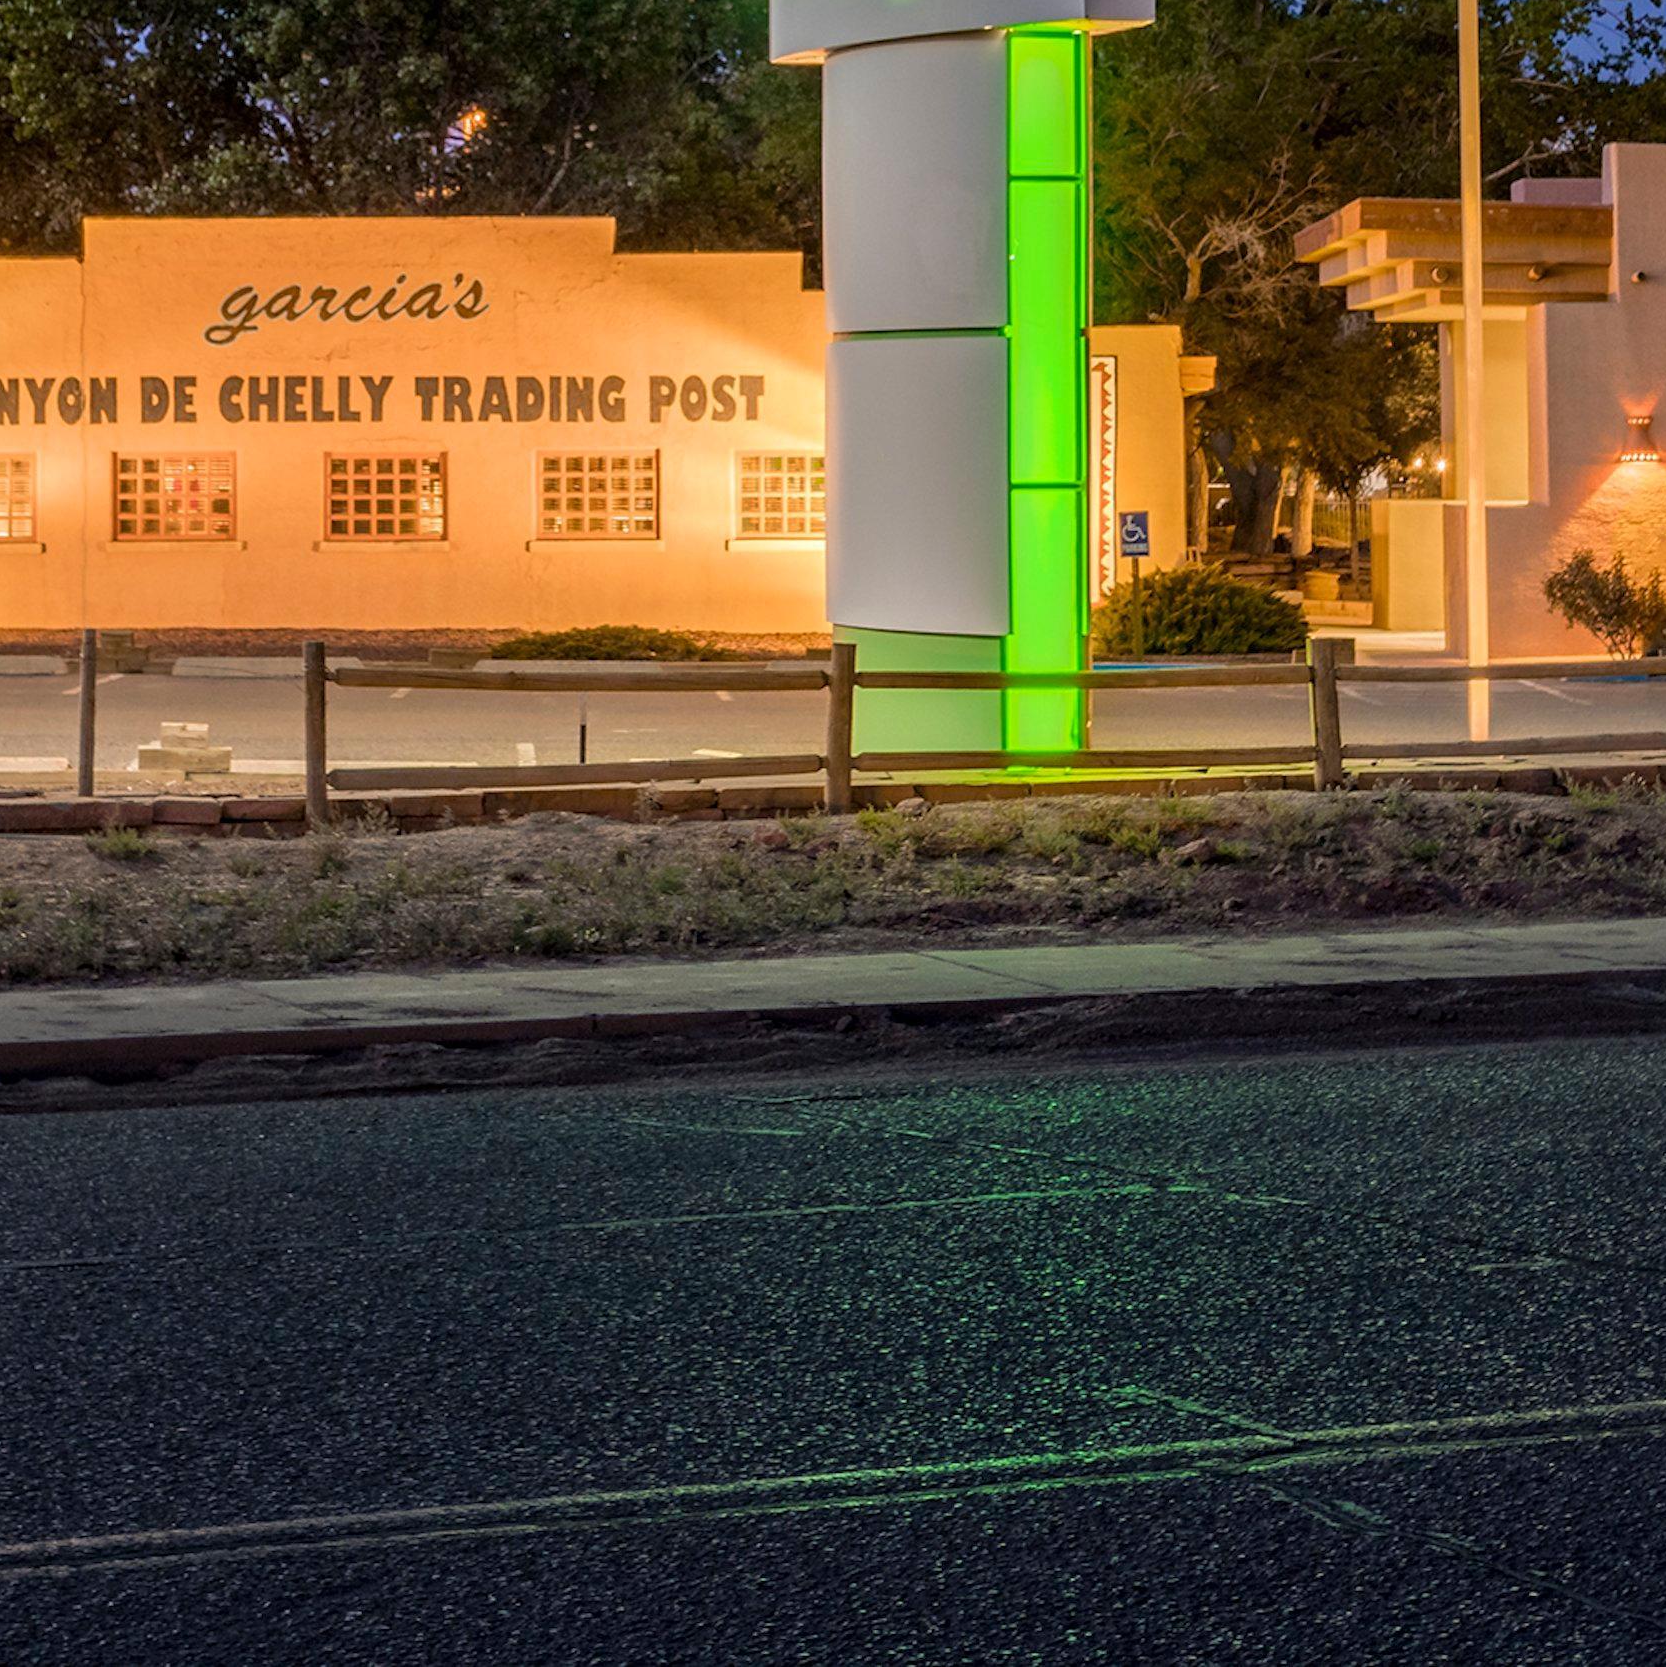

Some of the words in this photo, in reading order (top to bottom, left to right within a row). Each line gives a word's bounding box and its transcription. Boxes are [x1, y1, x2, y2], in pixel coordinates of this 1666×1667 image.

[204, 273, 489, 345] garcia's
[141, 376, 197, 423] DE
[219, 375, 394, 423] CHELLY
[414, 375, 626, 423] TRADING
[649, 375, 765, 422] POST
